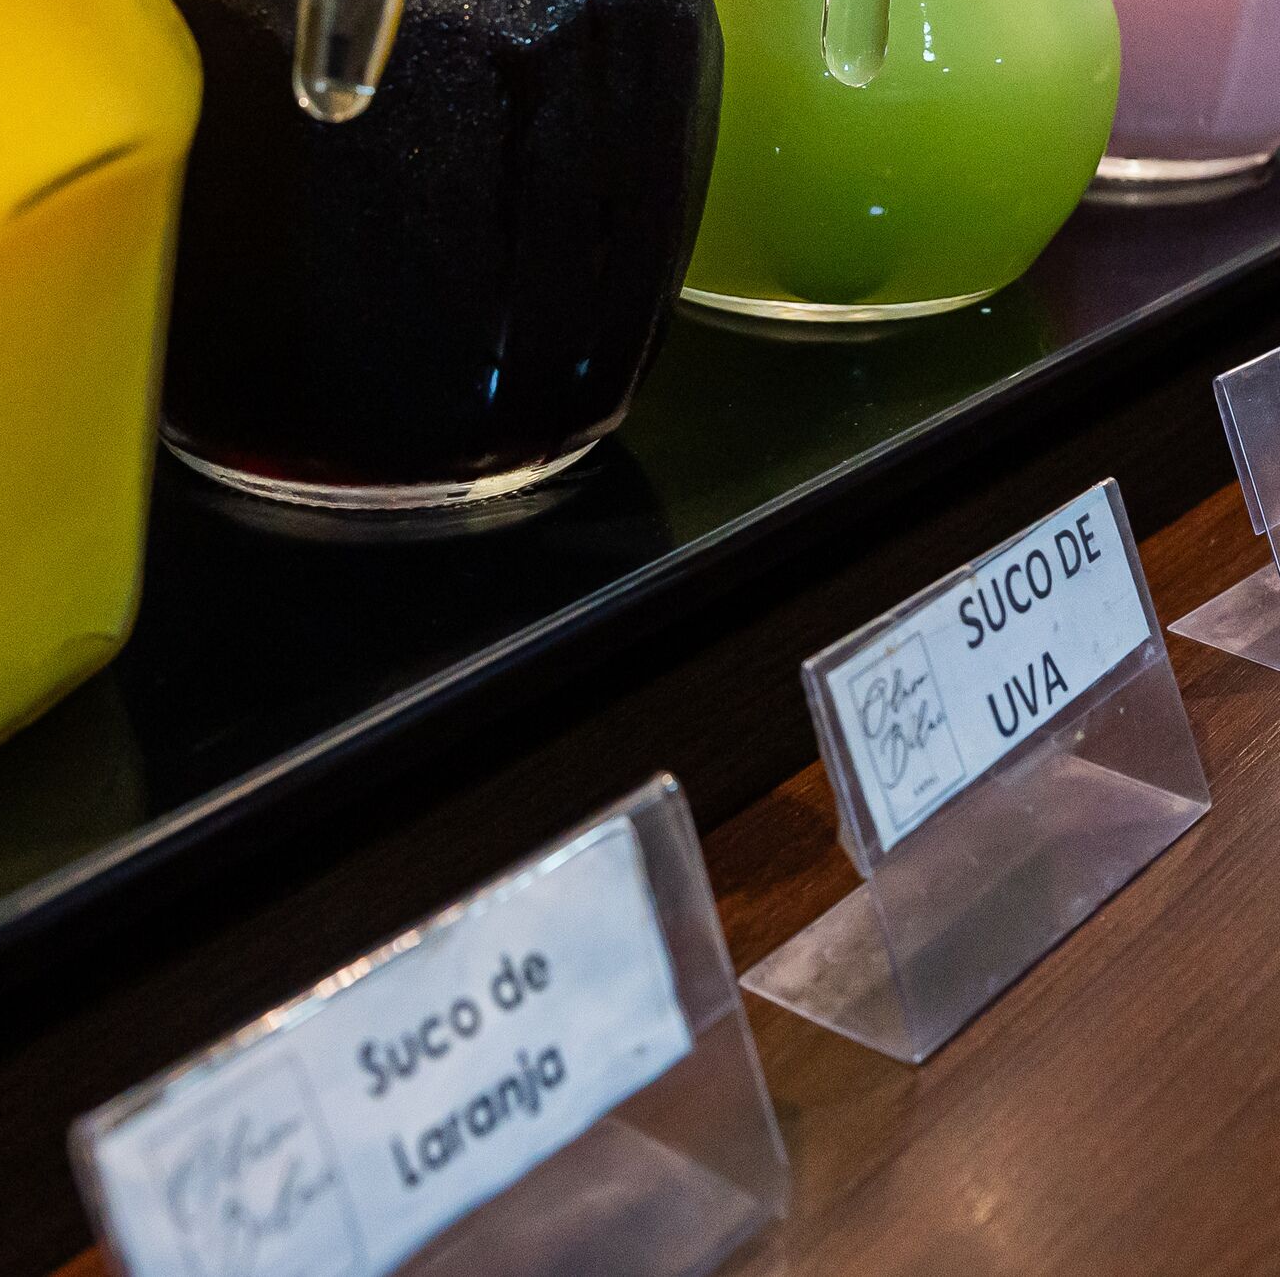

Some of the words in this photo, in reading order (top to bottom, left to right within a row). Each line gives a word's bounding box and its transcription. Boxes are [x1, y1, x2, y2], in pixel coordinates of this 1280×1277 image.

[958, 549, 1052, 649] SUCO
[1054, 513, 1101, 579] DE
[988, 651, 1069, 738] UVA
[357, 996, 484, 1099] Suco
[490, 949, 550, 1011] de
[388, 1041, 567, 1189] Laranja
